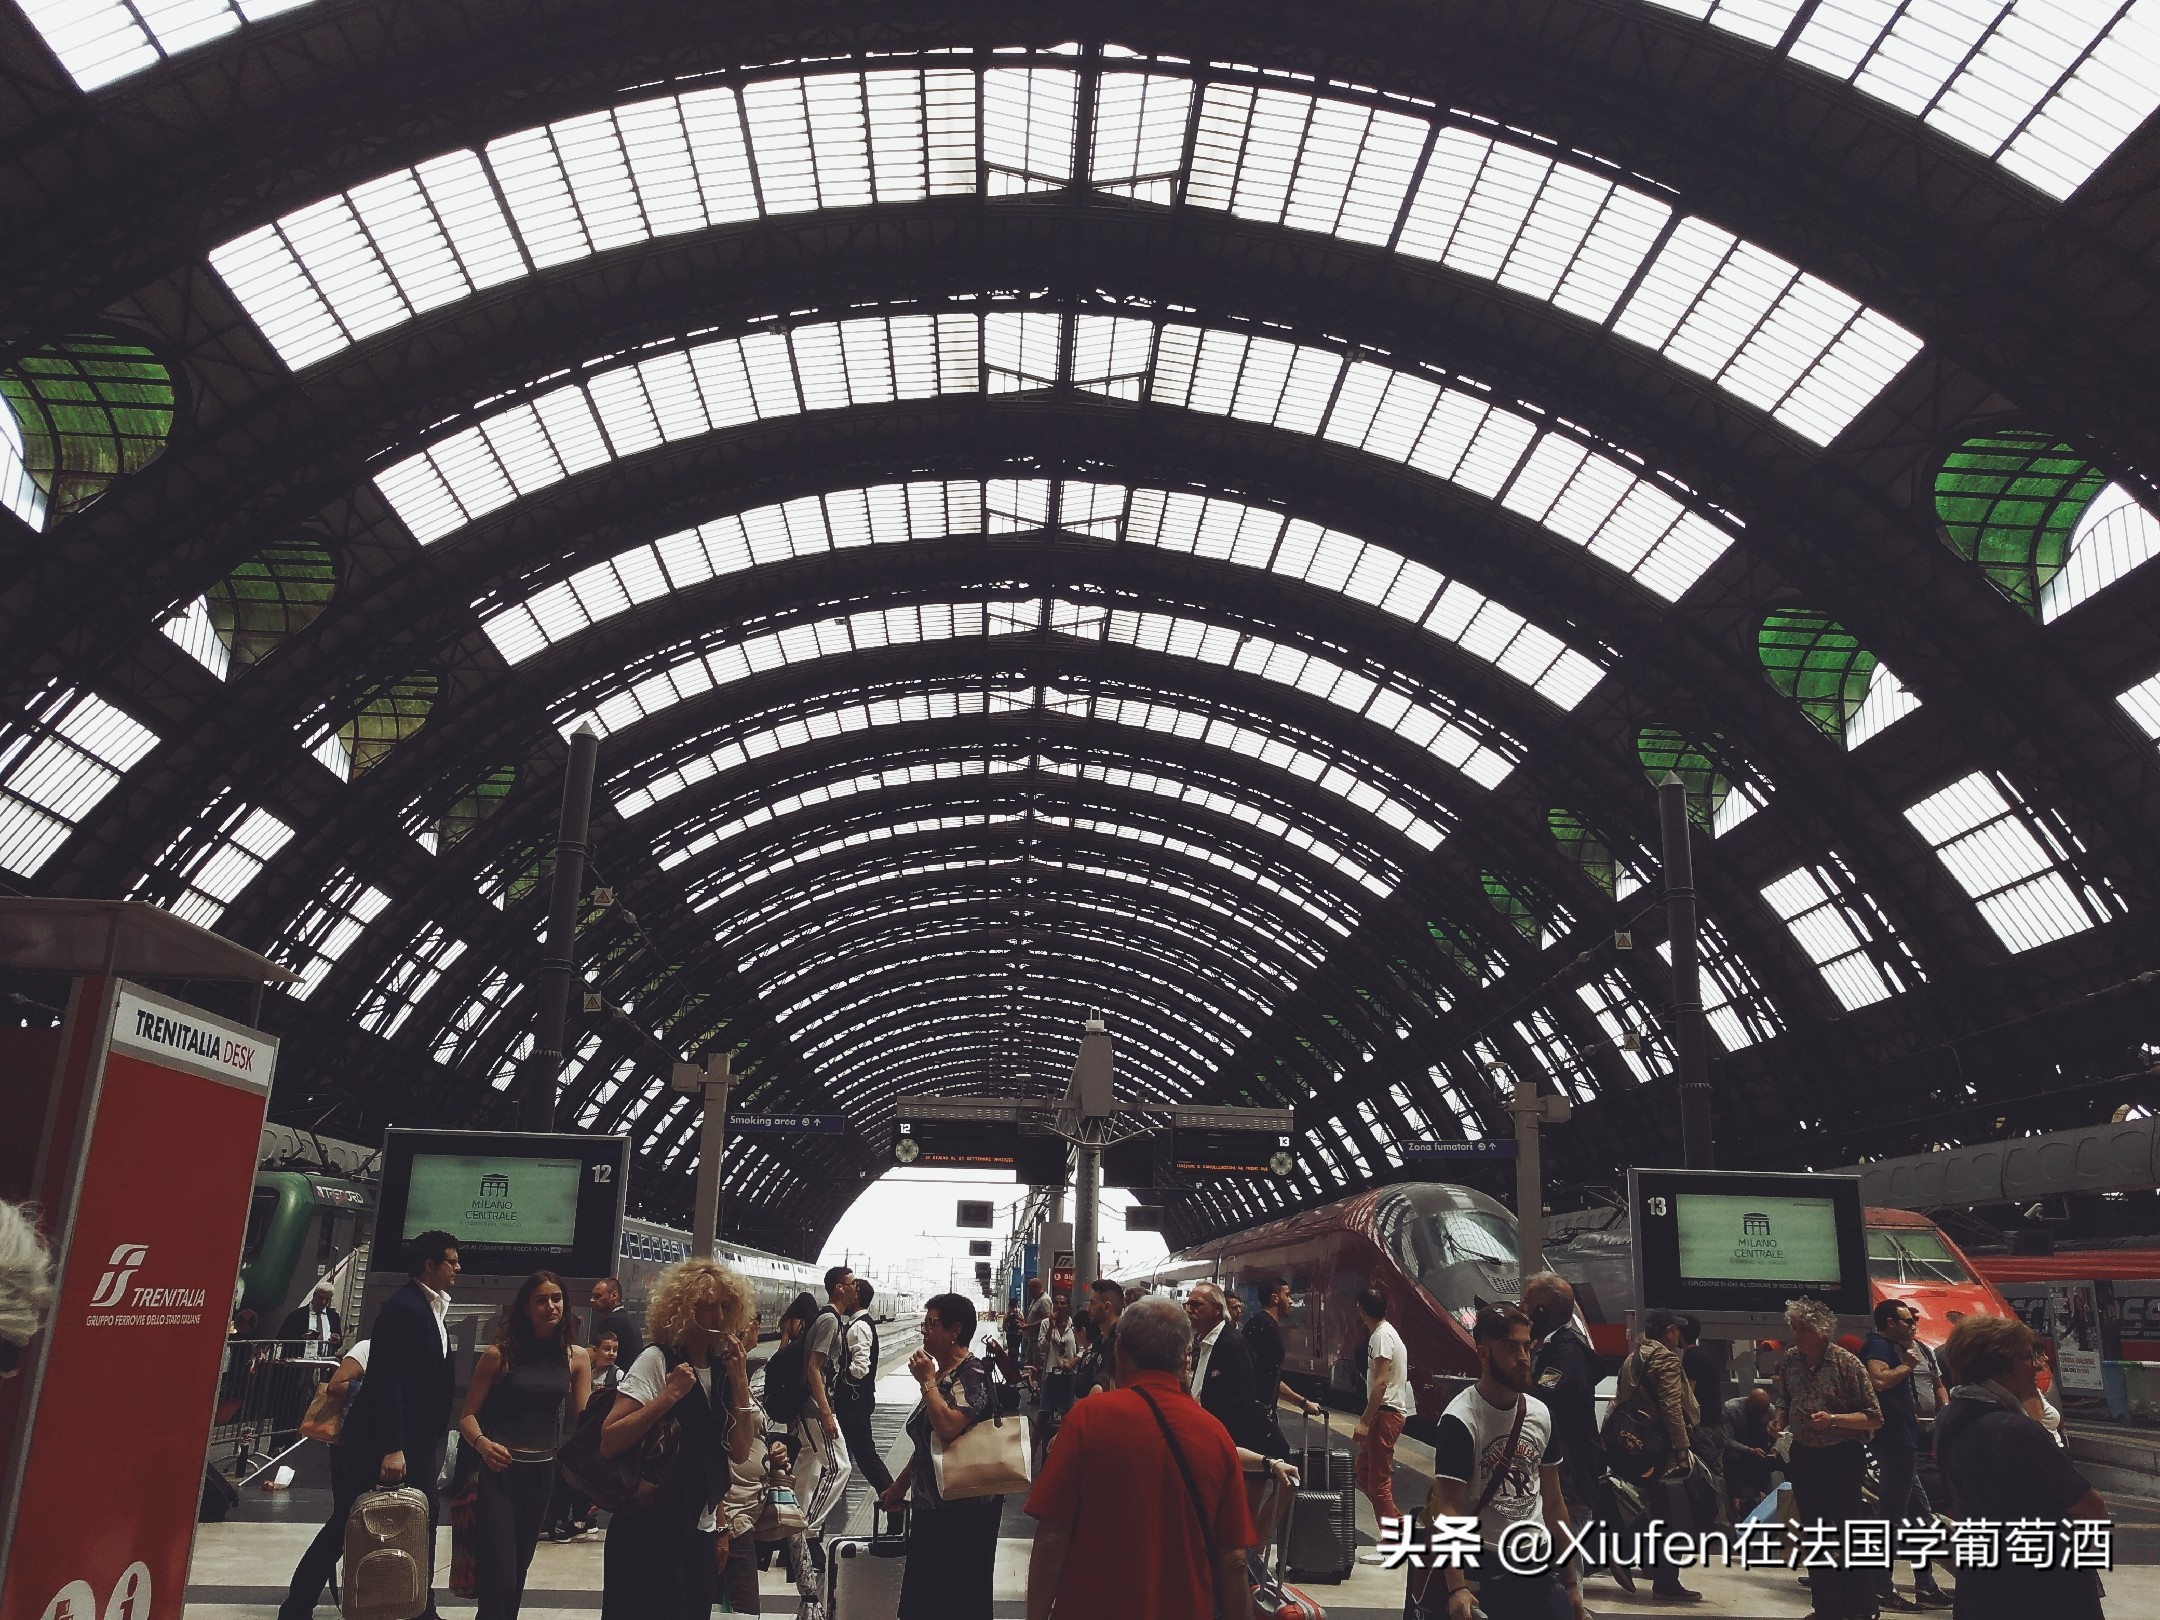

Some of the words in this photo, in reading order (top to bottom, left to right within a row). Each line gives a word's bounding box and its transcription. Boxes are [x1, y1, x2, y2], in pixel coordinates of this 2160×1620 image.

[135, 1009, 221, 1061] TRENITALIA
[223, 1040, 256, 1072] DESK
[730, 1115, 772, 1127] Smoking
[774, 1118, 796, 1126] area
[899, 1123, 911, 1134] 12
[1278, 1136, 1290, 1147] 13
[1408, 1142, 1432, 1151] Zona
[1434, 1141, 1474, 1151] fumatori
[591, 1164, 612, 1183] 12
[472, 1200, 513, 1210] MILANO
[1647, 1196, 1667, 1217] 13
[465, 1210, 517, 1221] CENTRALE
[1738, 1238, 1777, 1248] MILANO
[1733, 1248, 1783, 1259] CENTRALE
[131, 1287, 206, 1307] TRENITALIA
[86, 1315, 114, 1327] GRUPPO
[115, 1314, 146, 1326] FERROVIE
[146, 1314, 165, 1326] DELLO
[165, 1314, 181, 1325] STATO
[181, 1314, 201, 1325] ITALIANE
